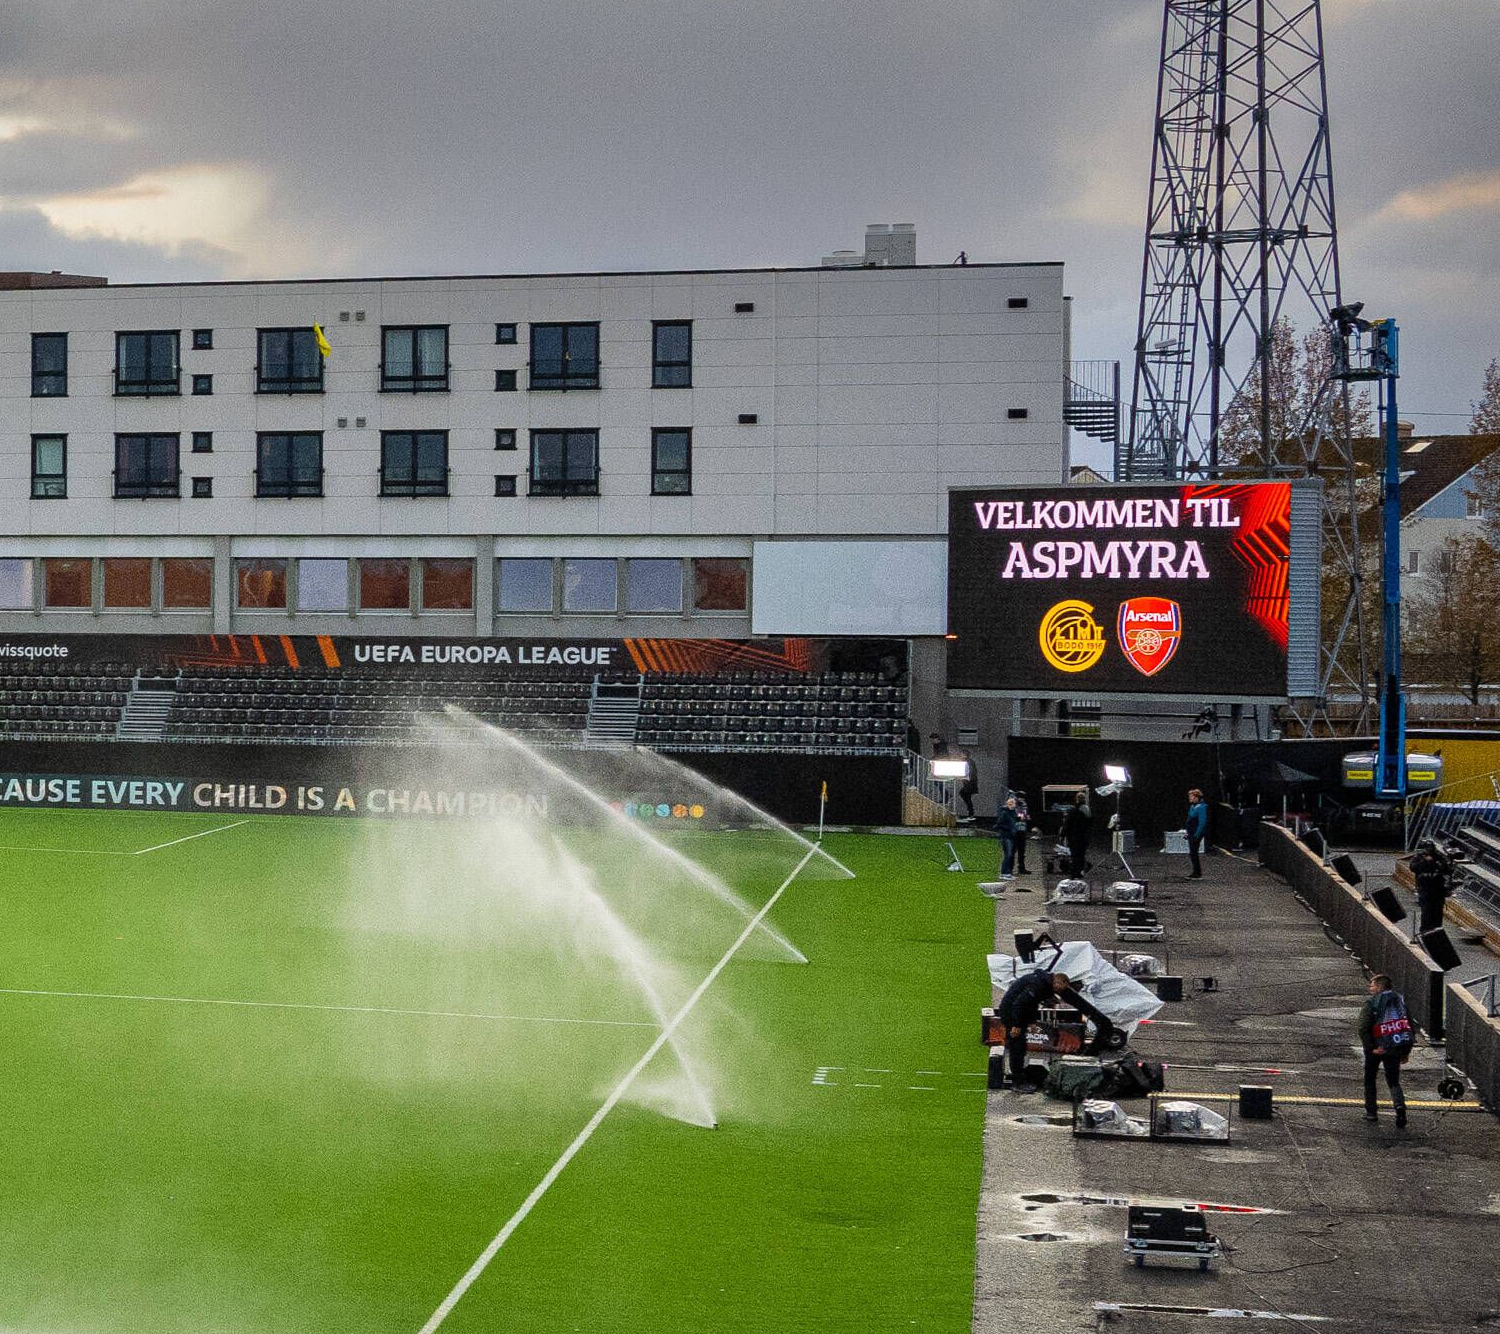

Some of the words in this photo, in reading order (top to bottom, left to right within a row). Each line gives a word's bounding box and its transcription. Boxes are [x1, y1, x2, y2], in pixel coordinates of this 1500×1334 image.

[975, 499, 1180, 529] VELKOMMEN
[1186, 499, 1240, 527] TIL
[1002, 540, 1209, 579] ASPMYRA
[1126, 610, 1172, 622] Arsenal
[354, 645, 415, 663] UEFA
[421, 646, 512, 664] EUROPA
[91, 780, 185, 805] EVERY
[193, 783, 287, 809] CHILD
[298, 786, 324, 810] IS
[334, 787, 356, 812] A
[366, 789, 548, 819] CHAMPION
